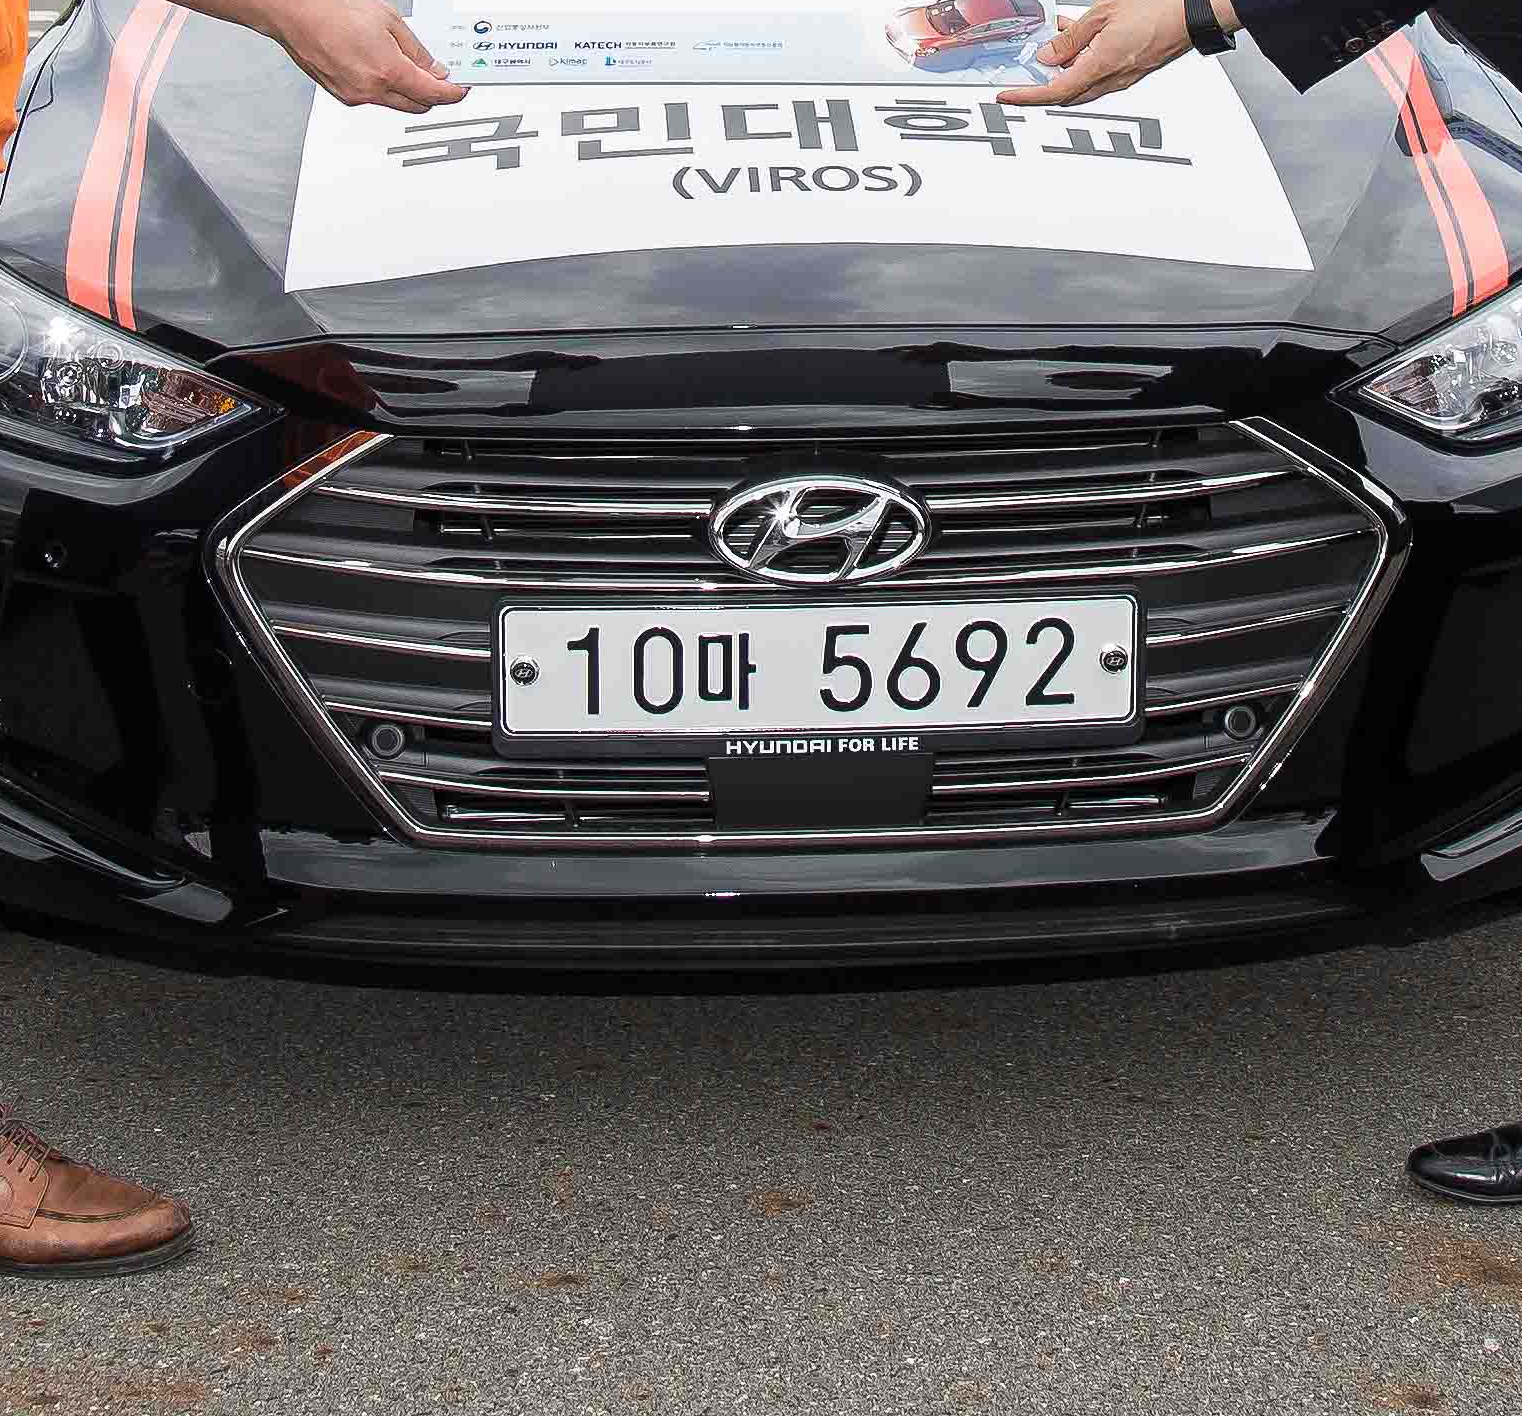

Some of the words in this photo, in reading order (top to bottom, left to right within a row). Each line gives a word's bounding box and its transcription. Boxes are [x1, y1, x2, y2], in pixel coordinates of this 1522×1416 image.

[498, 42, 558, 50] HYUNDAI
[574, 41, 622, 50] KATECH
[387, 98, 1194, 171] 국민대학교
[672, 163, 923, 200] (VIROS)
[566, 626, 757, 716] 10마
[819, 617, 1075, 713] 5692
[725, 740, 832, 755] HYUNDAI
[838, 738, 875, 753] FOR
[881, 736, 919, 752] LIFE
